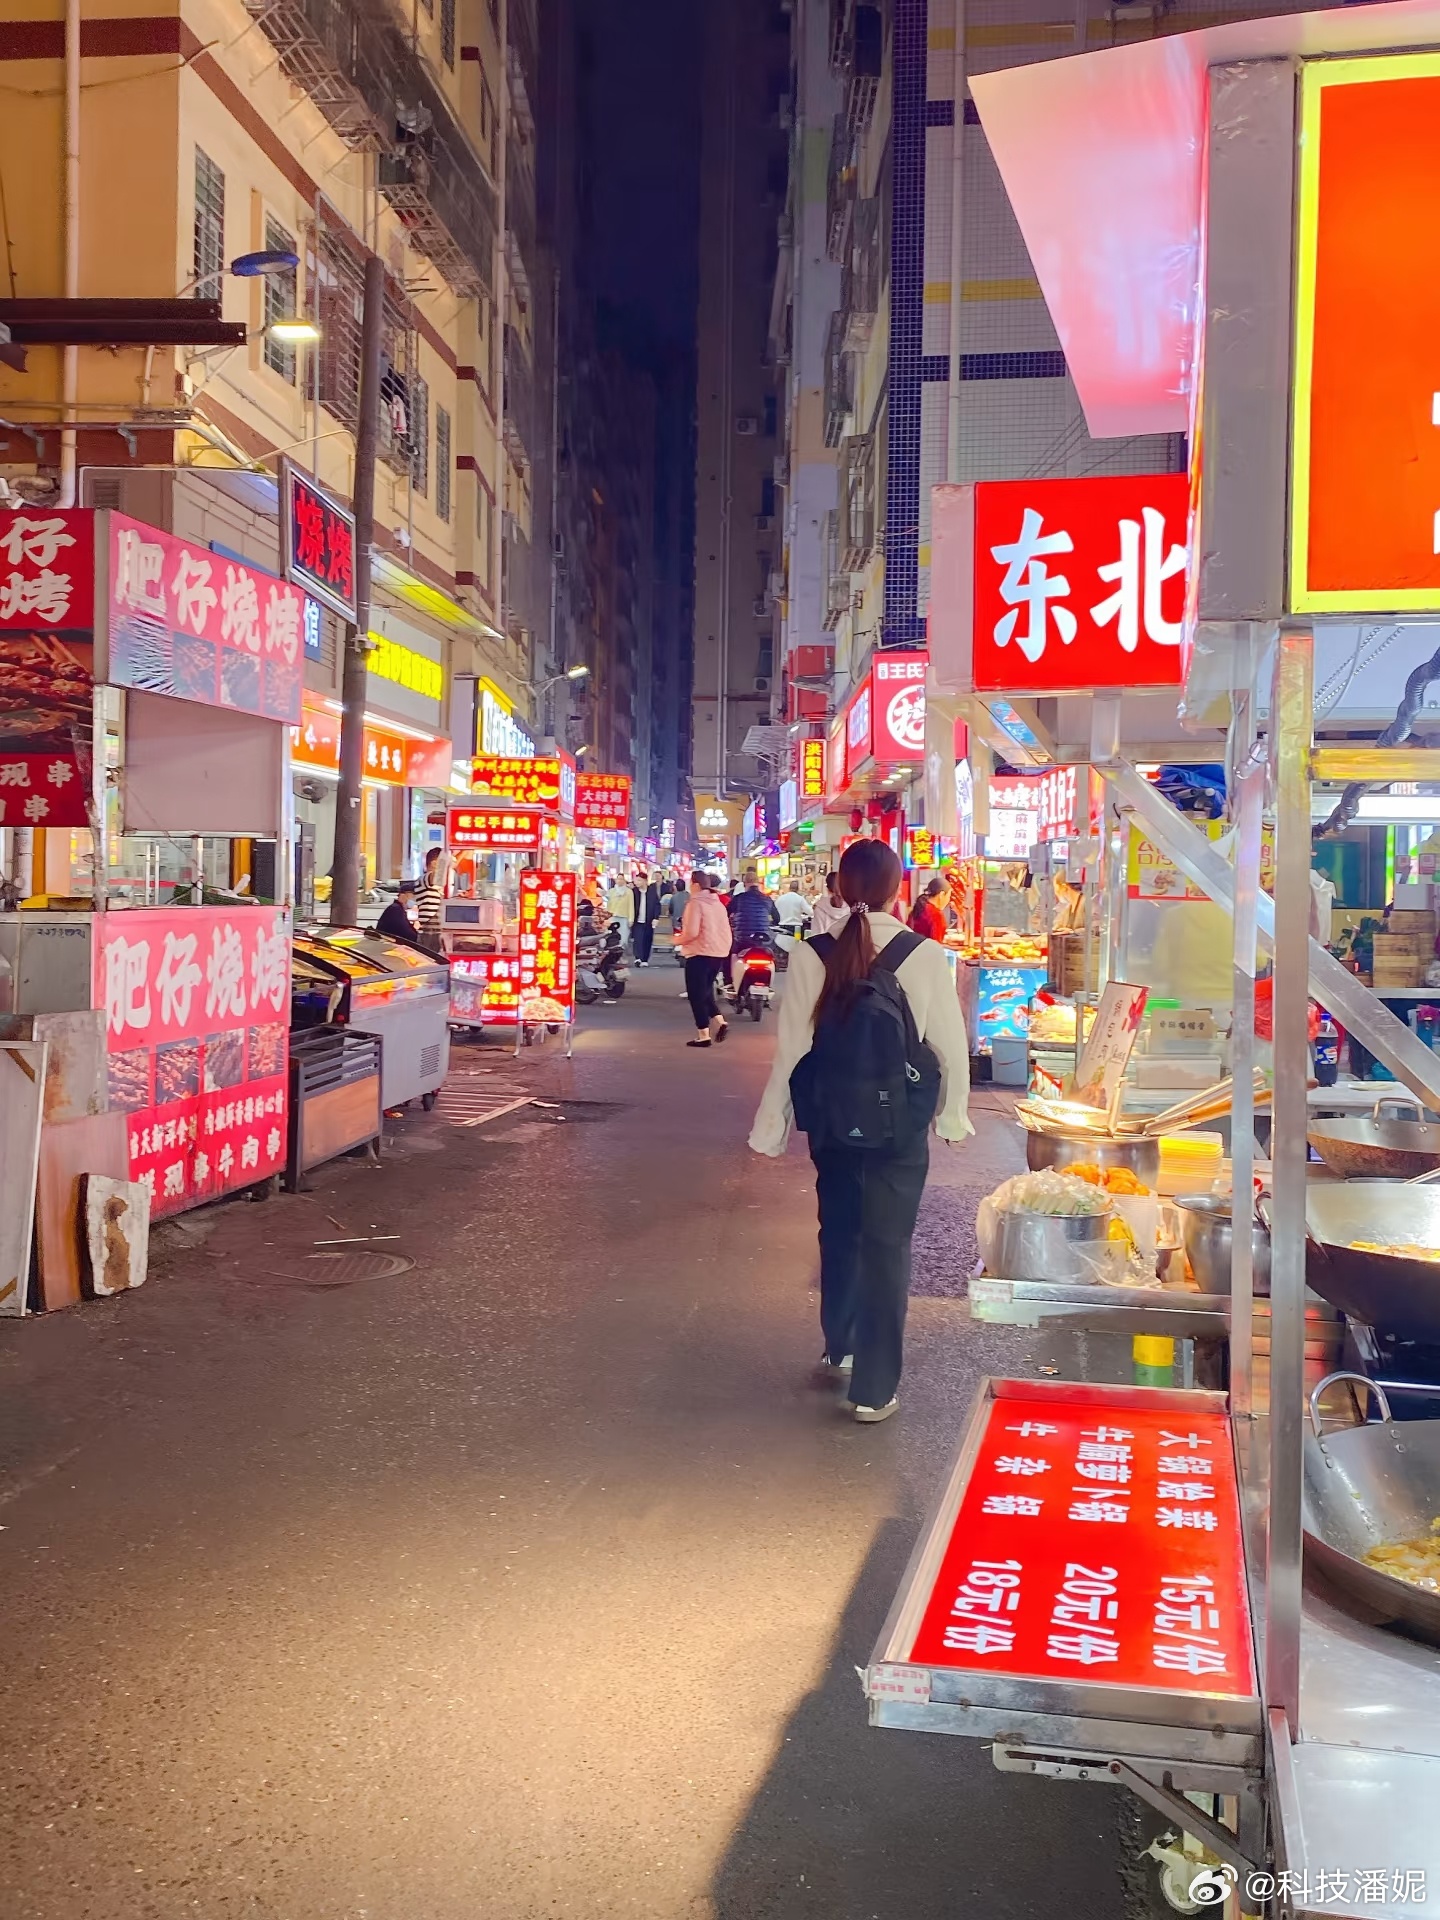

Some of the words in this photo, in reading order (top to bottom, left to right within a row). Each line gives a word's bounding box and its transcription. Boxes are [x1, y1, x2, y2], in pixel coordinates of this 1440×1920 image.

[0, 517, 76, 567] 仔
[296, 487, 353, 599] 烧烤
[990, 506, 1190, 663] 东北
[0, 569, 74, 622] 烤
[116, 528, 301, 665] 肥仔烧烤
[889, 663, 929, 679] 王氏
[576, 776, 629, 790] 东北特色
[105, 923, 289, 1035] 肥仔烧烤
[536, 889, 558, 990] 脆皮手撕鸡
[982, 1421, 1058, 1516] 牛杂锅
[1069, 1426, 1134, 1523] 牛腩萝卜锅
[1155, 1430, 1218, 1531] 大锅烩菜
[943, 1559, 1023, 1654] 18元/份
[1046, 1563, 1120, 1664] 20元/份
[1153, 1575, 1226, 1675] 15元/份
